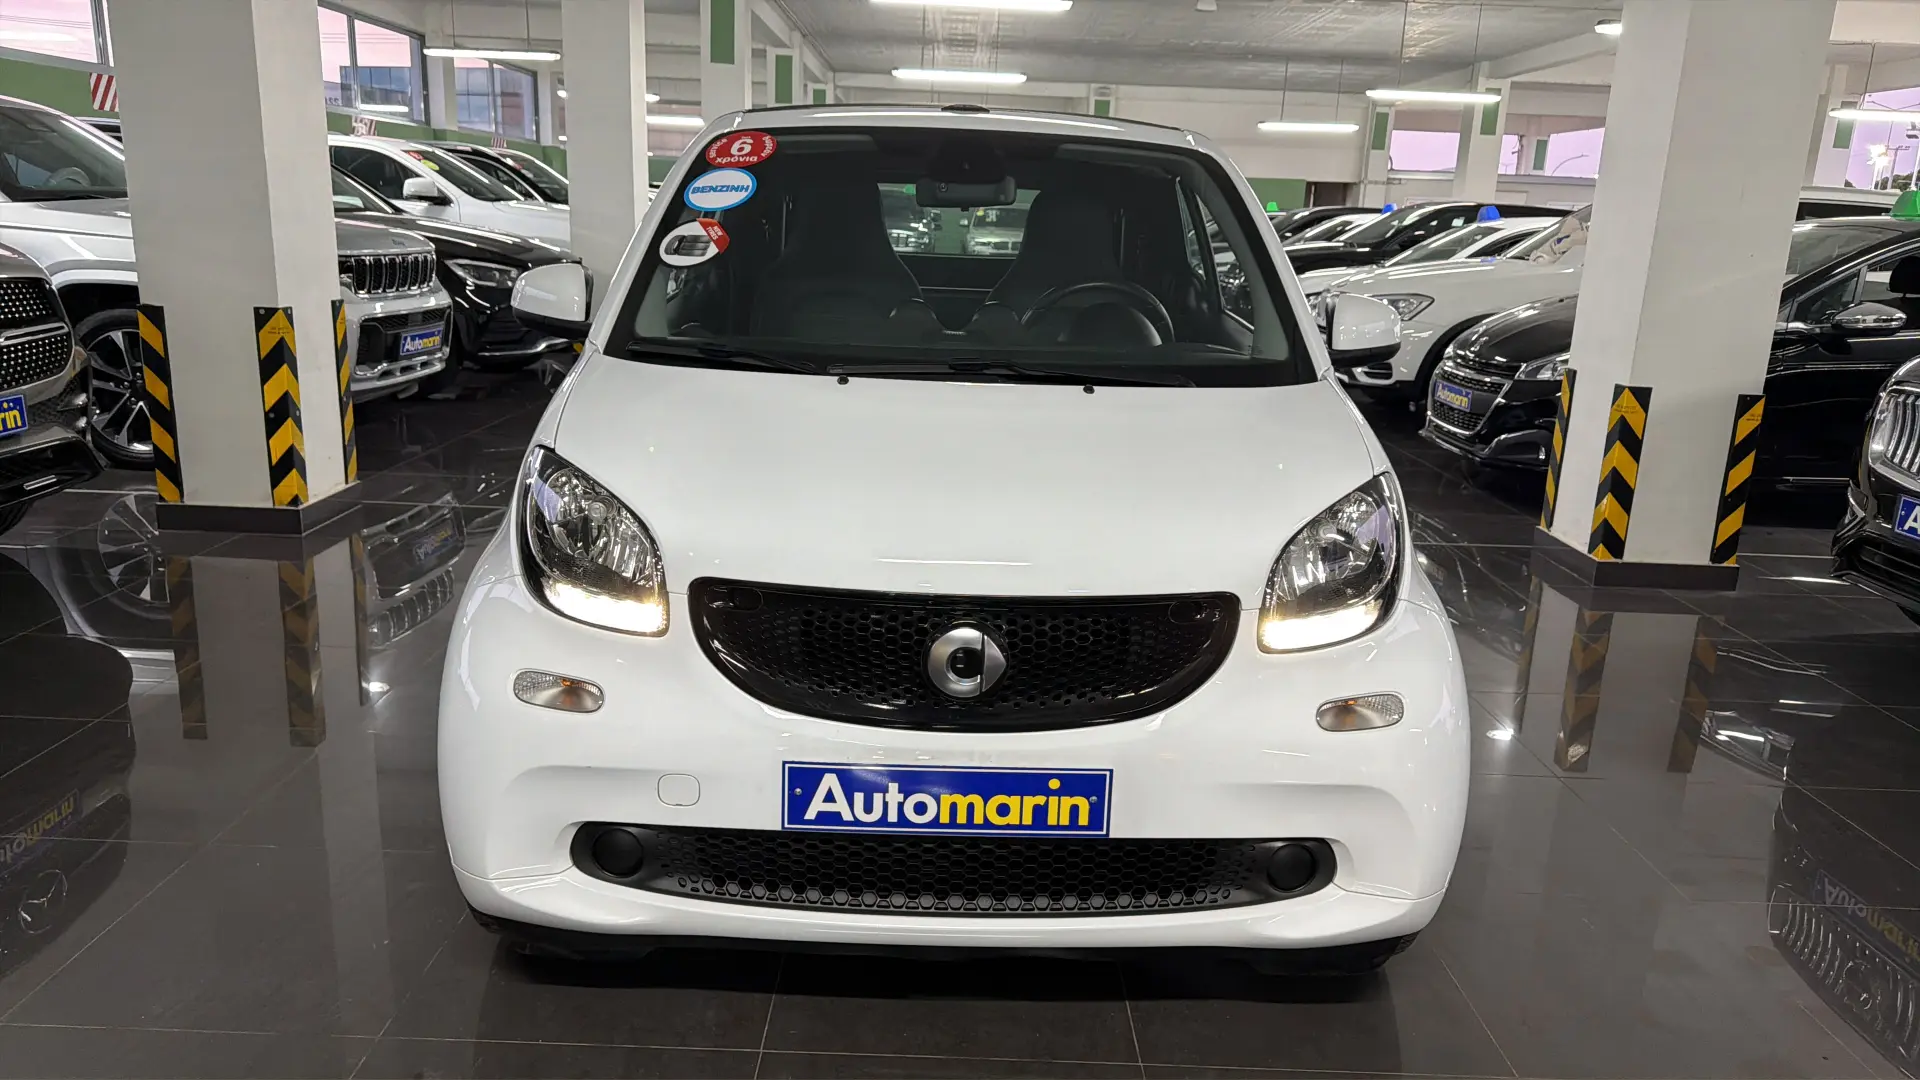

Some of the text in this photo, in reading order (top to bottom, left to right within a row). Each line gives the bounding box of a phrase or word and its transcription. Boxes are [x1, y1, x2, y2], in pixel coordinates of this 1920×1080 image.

[730, 138, 754, 156] 6
[715, 155, 758, 164] χρόνια
[713, 225, 724, 236] NEW
[403, 335, 441, 352] Automarin
[804, 773, 1091, 826] Automarin
